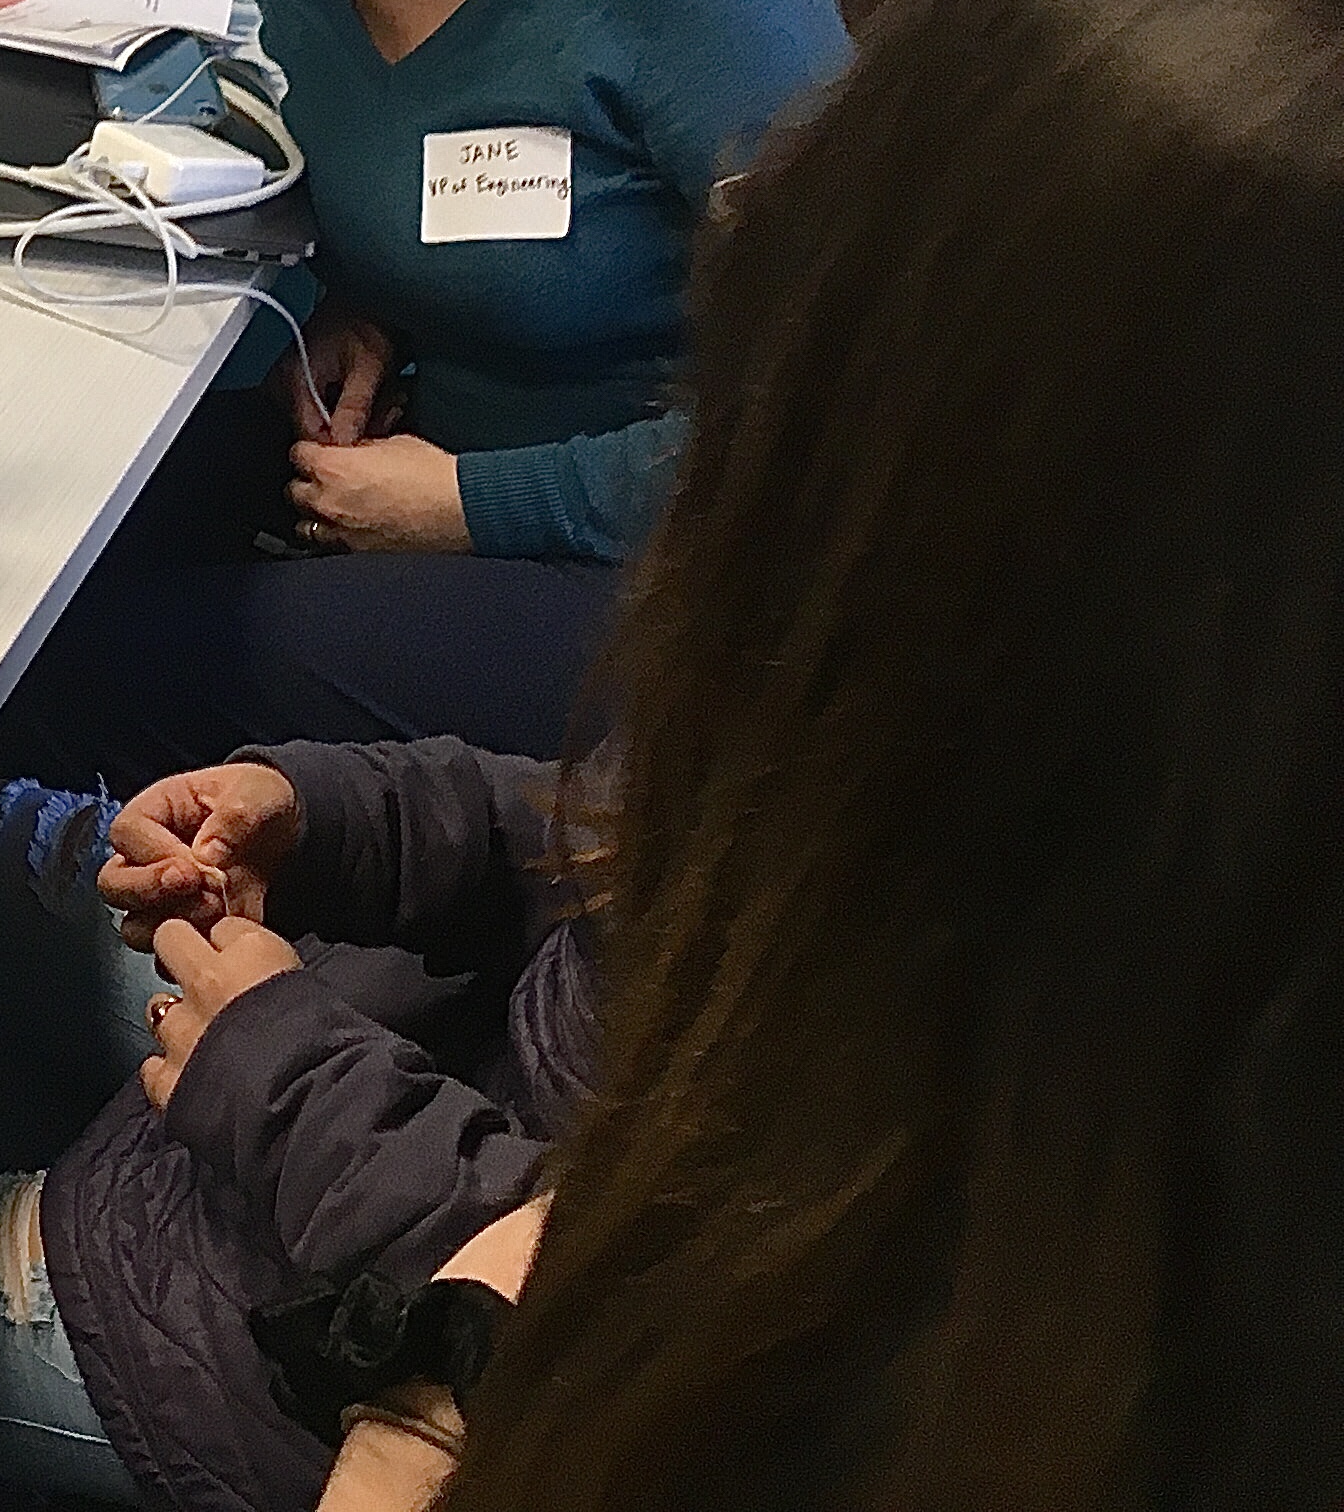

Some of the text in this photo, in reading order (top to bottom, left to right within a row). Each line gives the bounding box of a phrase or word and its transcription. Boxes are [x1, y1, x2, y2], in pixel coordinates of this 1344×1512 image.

[459, 138, 521, 165] JANE
[427, 175, 450, 197] VP
[474, 171, 571, 201] Engineering
